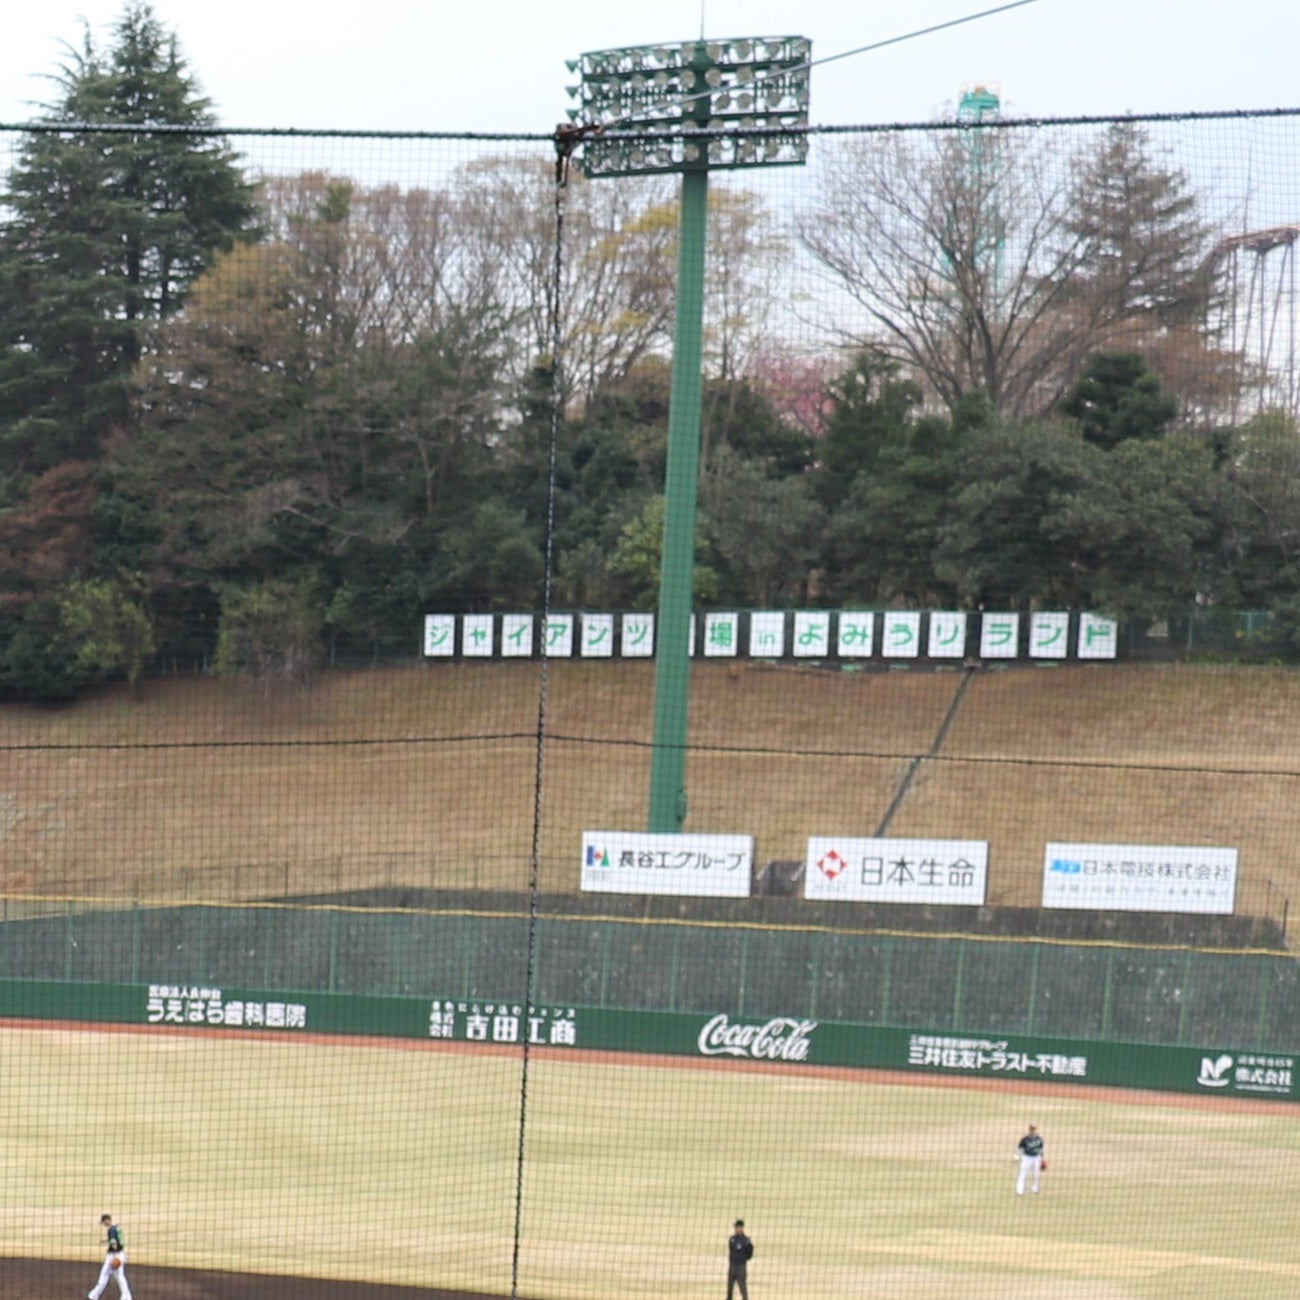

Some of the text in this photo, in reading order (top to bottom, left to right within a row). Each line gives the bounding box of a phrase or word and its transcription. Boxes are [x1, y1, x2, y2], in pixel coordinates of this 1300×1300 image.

[430, 621, 1112, 648] ジャイアンツ場 in よみうりランド
[619, 850, 747, 871] 長谷工グループ
[861, 855, 976, 889] 日本生命
[1083, 859, 1231, 882] 日本電技株式会社
[146, 998, 306, 1028] うえはら歯科医院
[466, 1014, 576, 1045] 吉田工商
[697, 1013, 818, 1061] Coca-Cola
[908, 1045, 1087, 1076] 三井住友トラスト不動産
